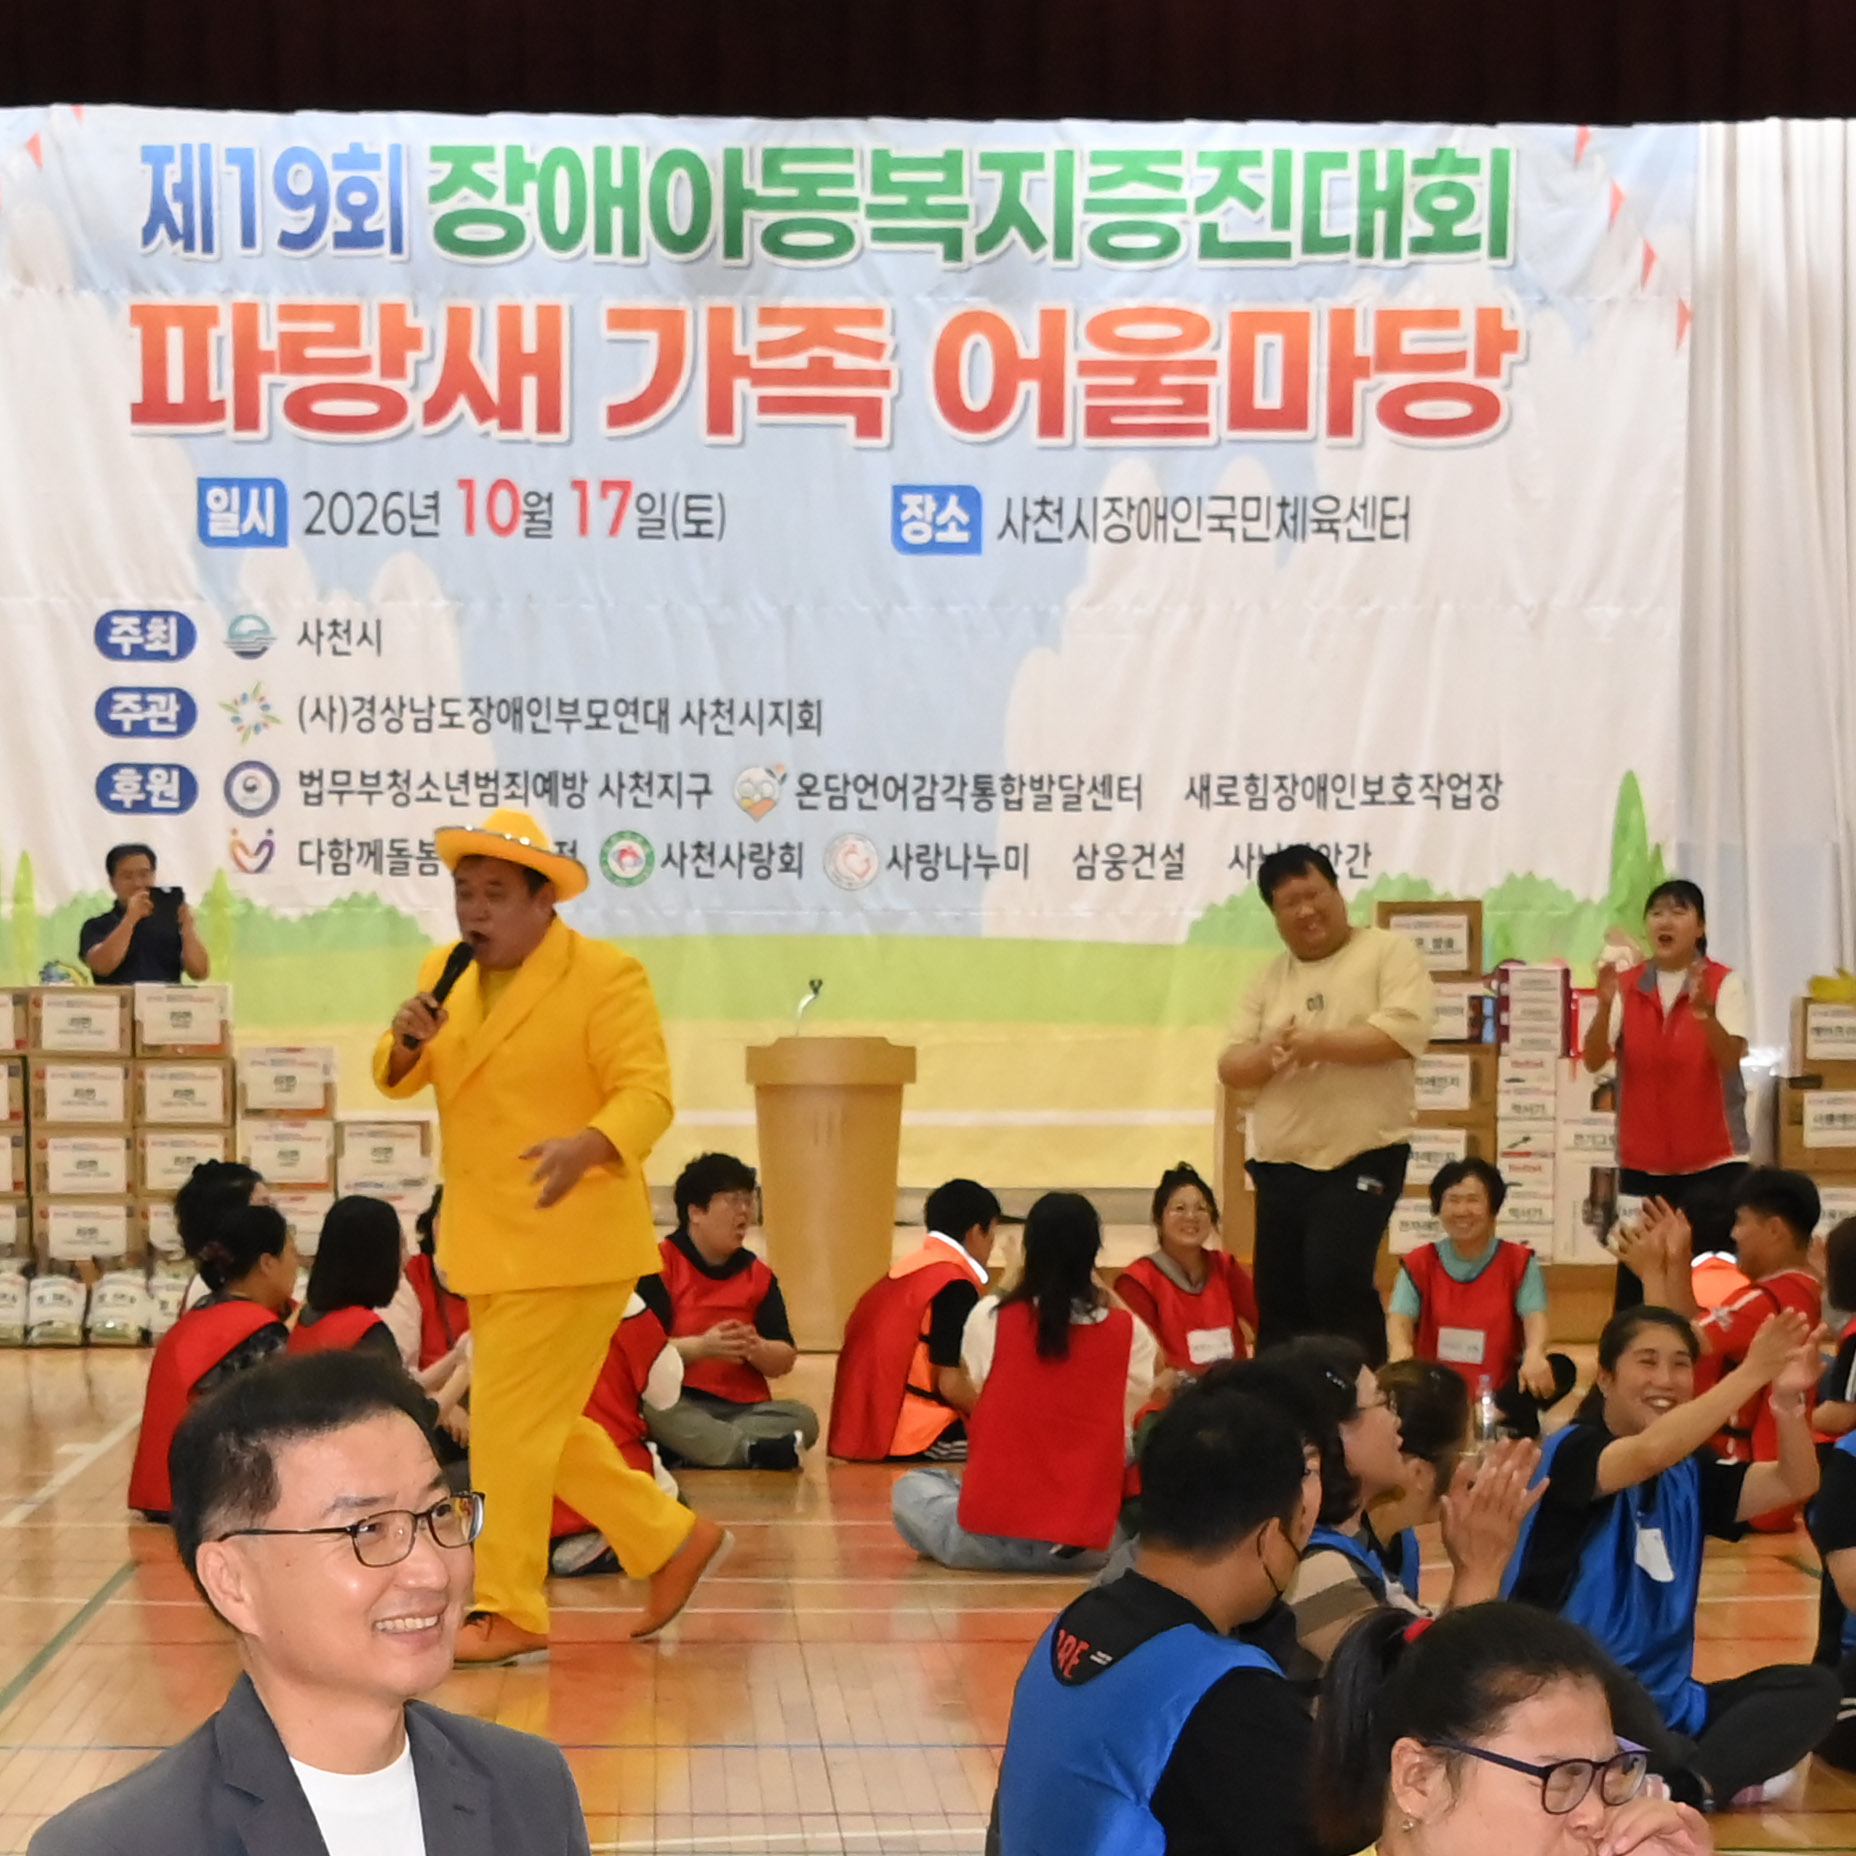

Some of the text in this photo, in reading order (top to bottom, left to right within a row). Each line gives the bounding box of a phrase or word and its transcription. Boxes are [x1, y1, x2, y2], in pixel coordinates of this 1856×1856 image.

[140, 142, 1511, 263] 제19회 장애아동복지증진대회
[129, 302, 1519, 440] 파랑새 가족 어울마당
[205, 476, 727, 543] 일시 2026년 10월 17일(토)
[899, 492, 1413, 545] 장소 사천시장애인국민체육센터
[108, 615, 384, 657] 주최 사천시
[109, 691, 823, 738] 주관 (사)경상남도장애인부모연대 사천시지회
[110, 767, 1504, 814] 후원 법무부청소년범죄예방 사천지구 온담언어감각통합발달센터 새로힘장애인보호작업장
[660, 839, 804, 880] 사천사랑회
[886, 841, 1031, 883] 사랑나누미
[1072, 841, 1186, 881] 삼웅건설
